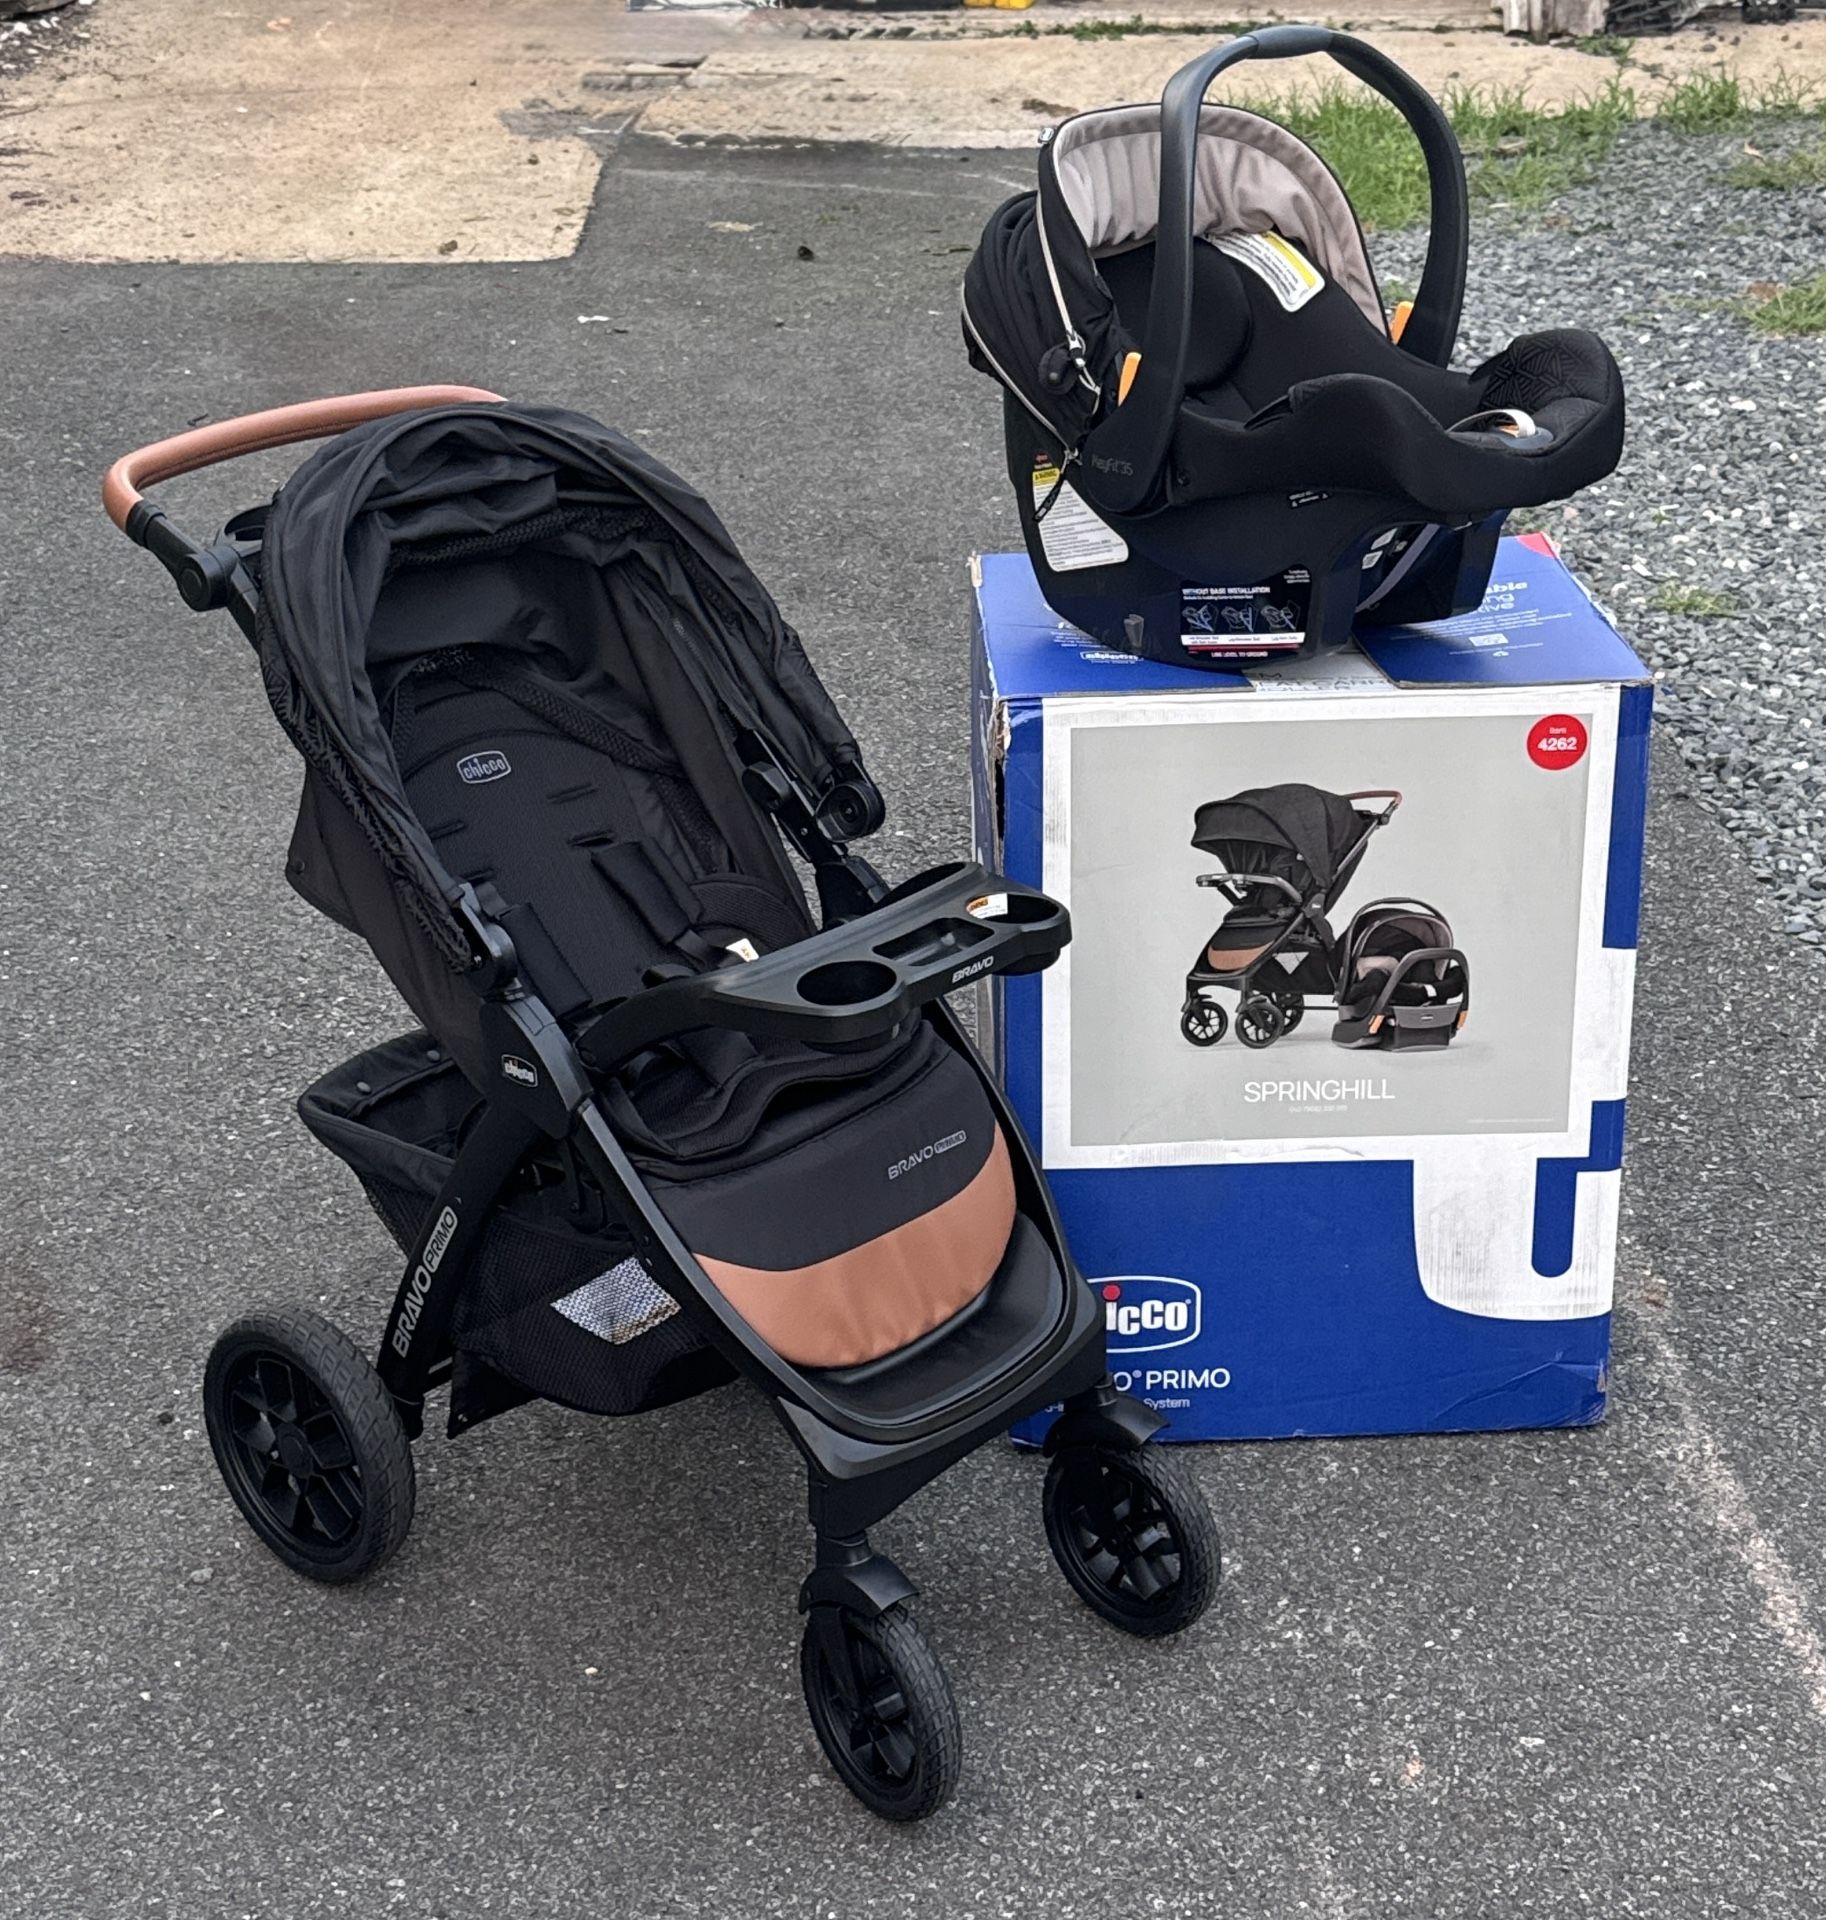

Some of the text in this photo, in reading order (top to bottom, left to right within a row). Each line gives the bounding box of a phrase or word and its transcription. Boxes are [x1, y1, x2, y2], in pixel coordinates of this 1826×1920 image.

[1485, 581, 1528, 594] able
[1537, 736, 1578, 752] 4262
[463, 757, 507, 780] chicco
[951, 955, 995, 983] BRAVO
[1243, 1079, 1396, 1103] SPRINGHILL
[887, 1145, 934, 1180] BRAVO
[392, 1207, 457, 1358] BRAVO PRIMO
[1103, 1284, 1190, 1336] icco
[1145, 1368, 1231, 1391] PRIMO
[1143, 1398, 1190, 1411] System
